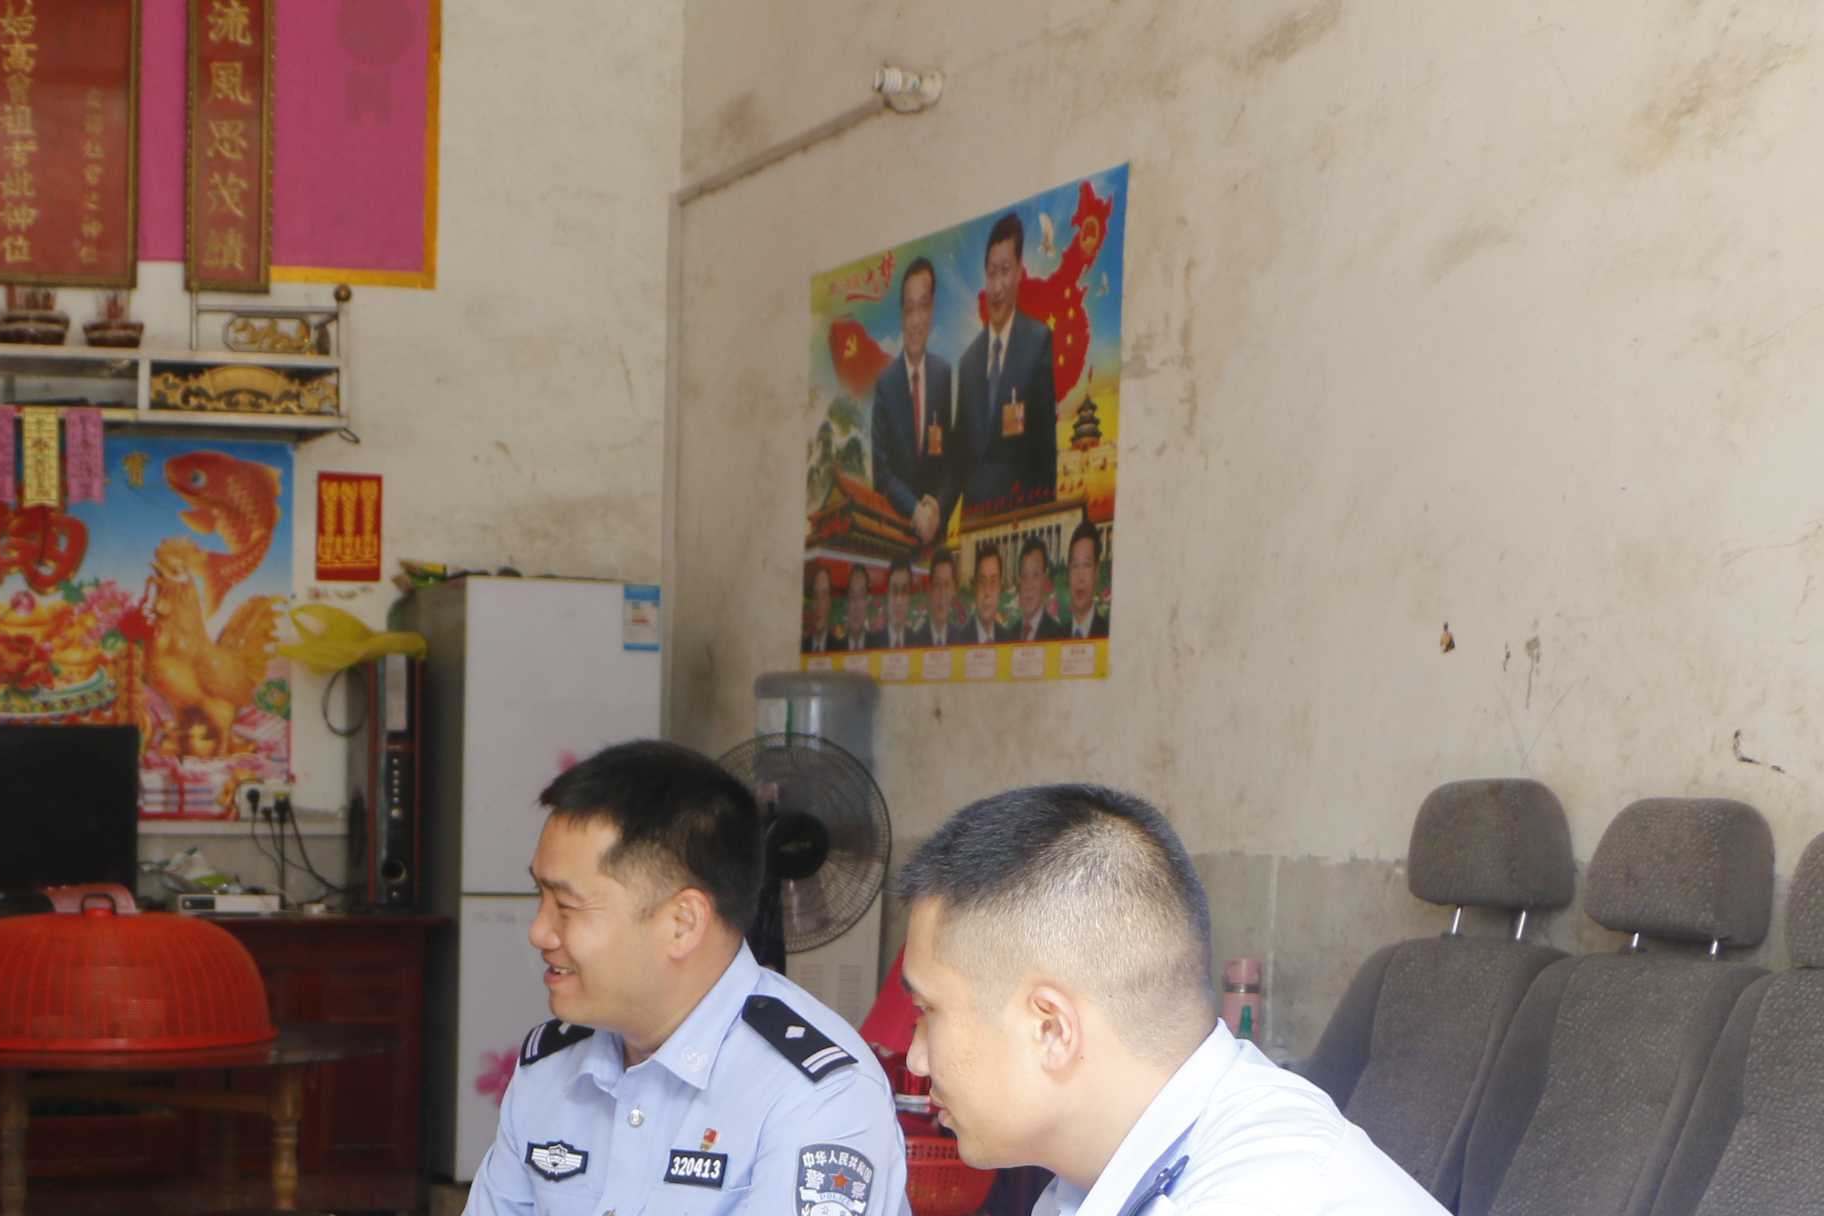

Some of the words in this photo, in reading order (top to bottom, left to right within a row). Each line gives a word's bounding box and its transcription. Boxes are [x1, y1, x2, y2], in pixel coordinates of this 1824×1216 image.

[670, 1156, 722, 1179] 320413
[802, 1150, 873, 1184] 中华人民共和国
